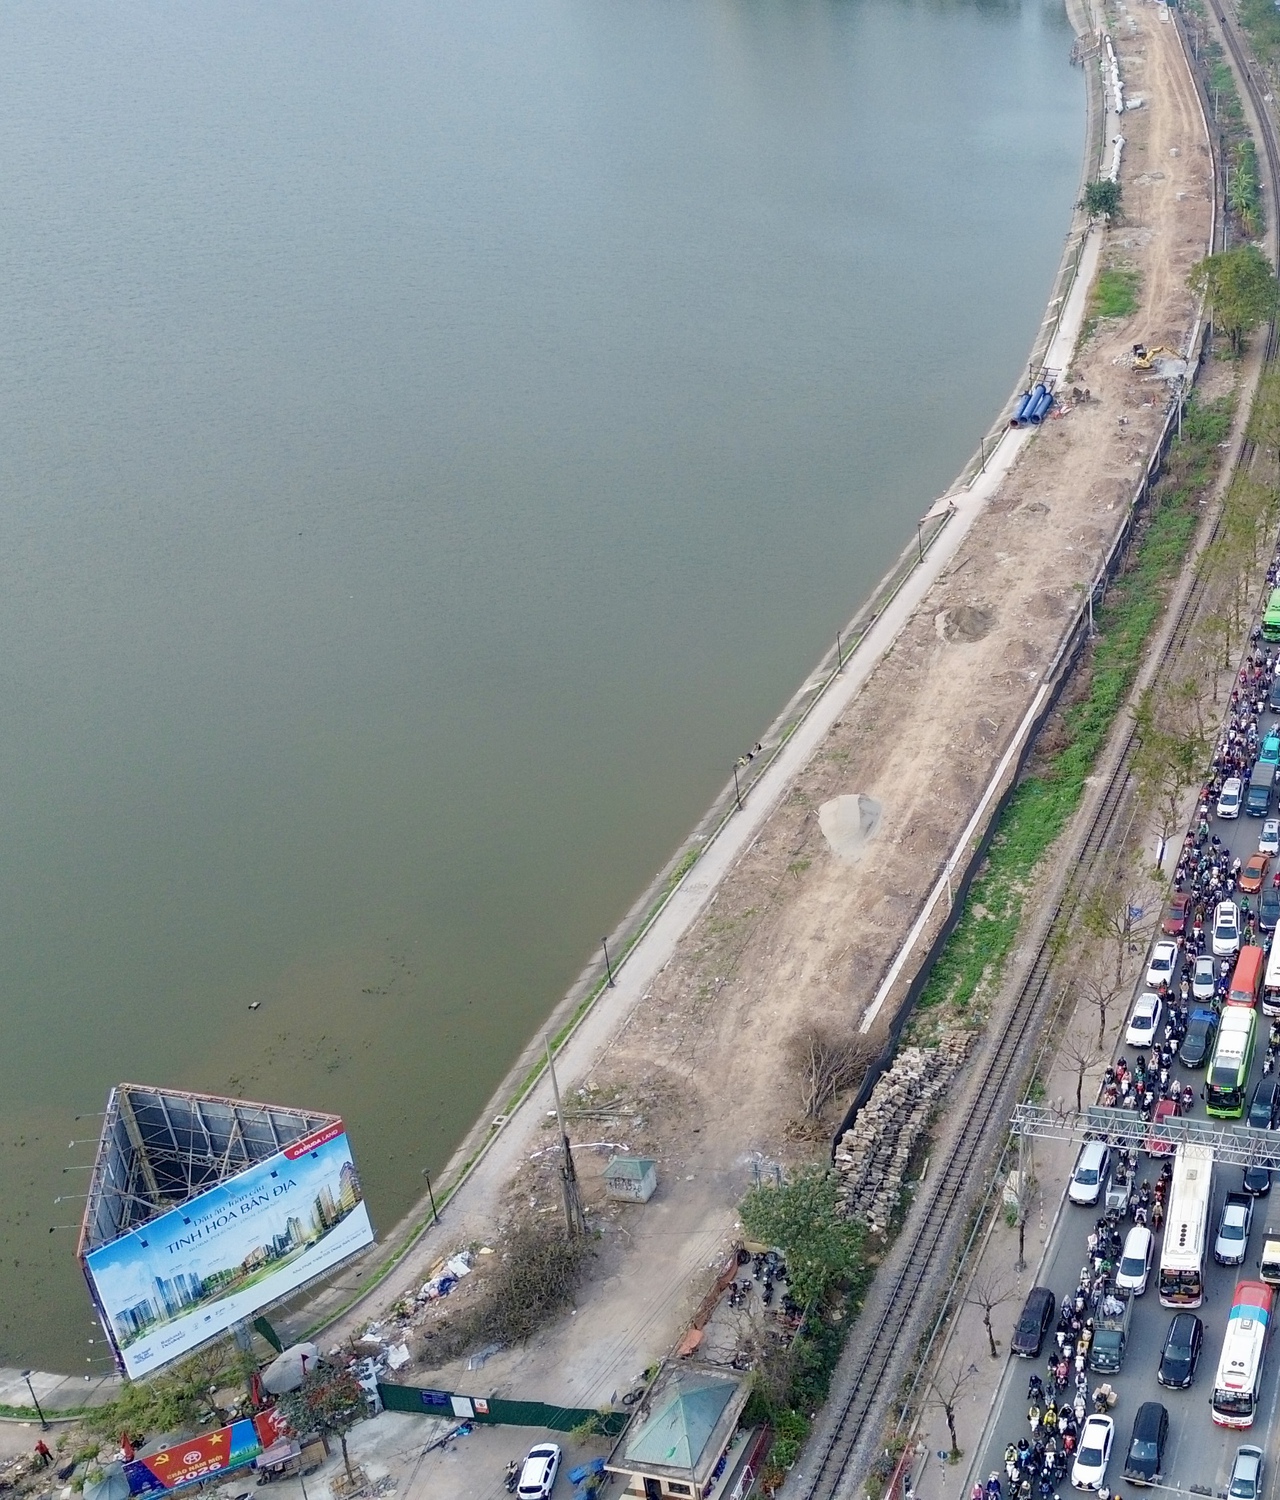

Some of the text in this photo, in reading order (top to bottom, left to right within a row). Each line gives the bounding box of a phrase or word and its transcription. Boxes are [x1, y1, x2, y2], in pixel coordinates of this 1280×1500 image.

[166, 1229, 202, 1254] TINH
[205, 1211, 238, 1234] HOA
[240, 1194, 270, 1215] BẢN
[272, 1179, 297, 1197] ĐỊA
[173, 1463, 222, 1485] 2026
